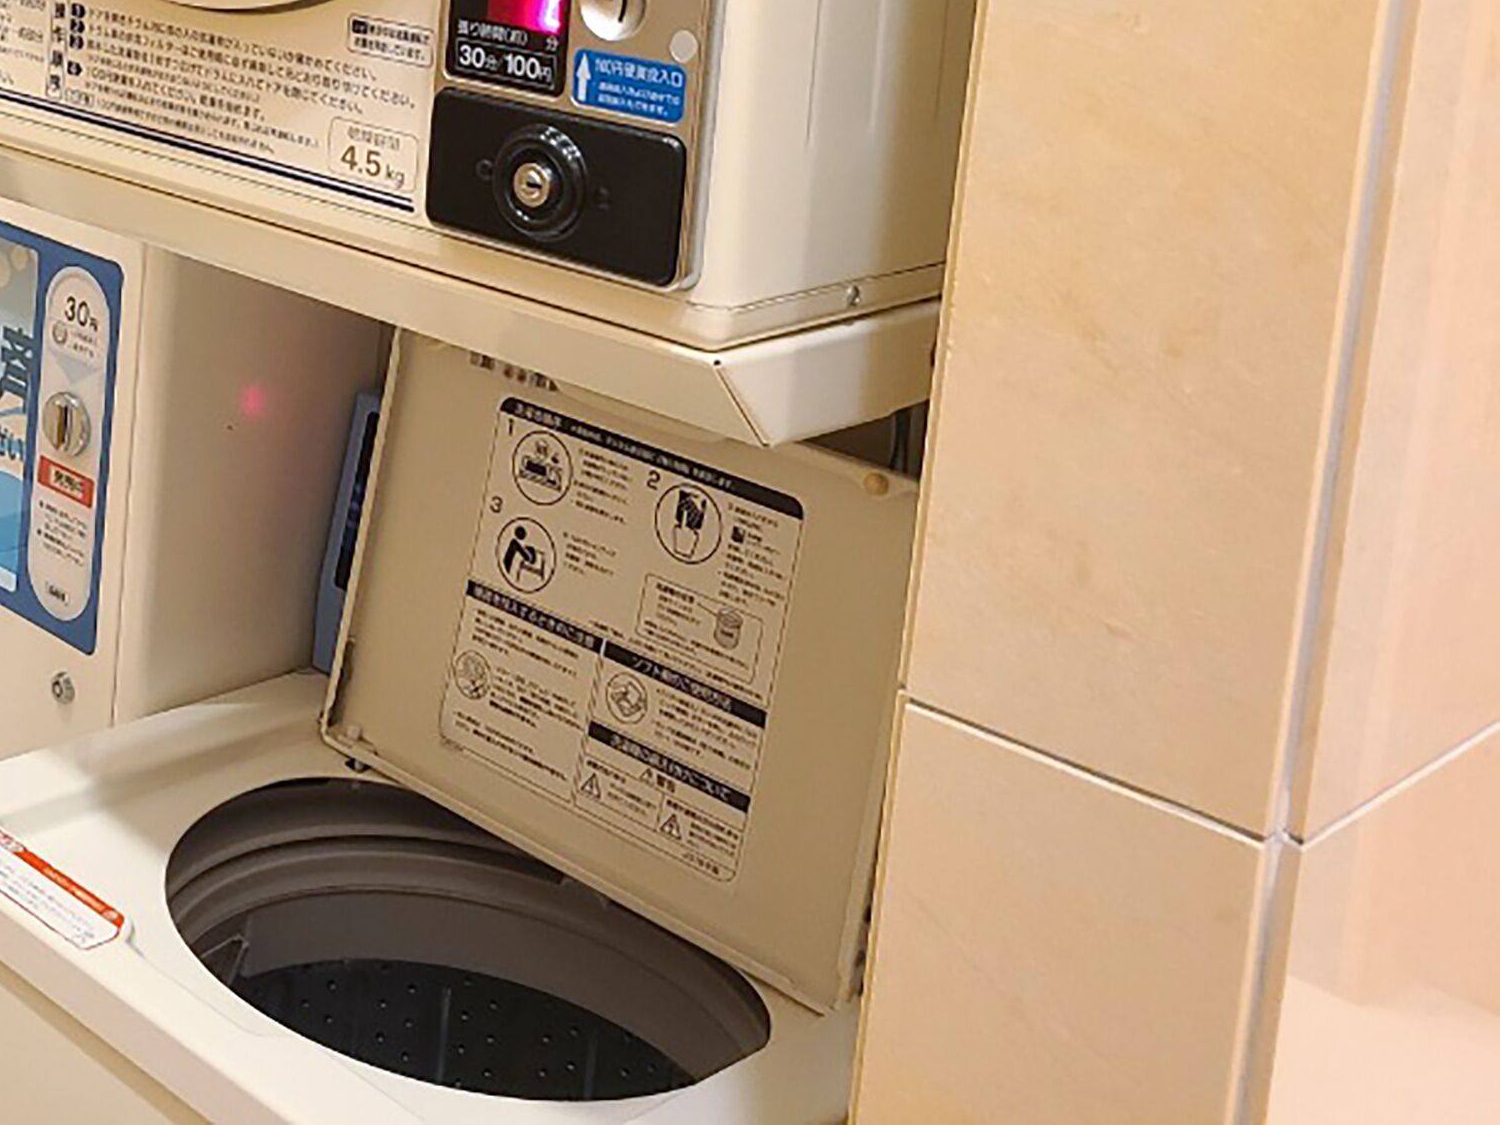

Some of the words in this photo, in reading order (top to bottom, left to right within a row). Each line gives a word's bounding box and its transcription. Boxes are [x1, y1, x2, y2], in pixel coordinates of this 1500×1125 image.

[504, 52, 552, 83] 100円
[646, 469, 662, 492] 2
[490, 496, 503, 514] 3
